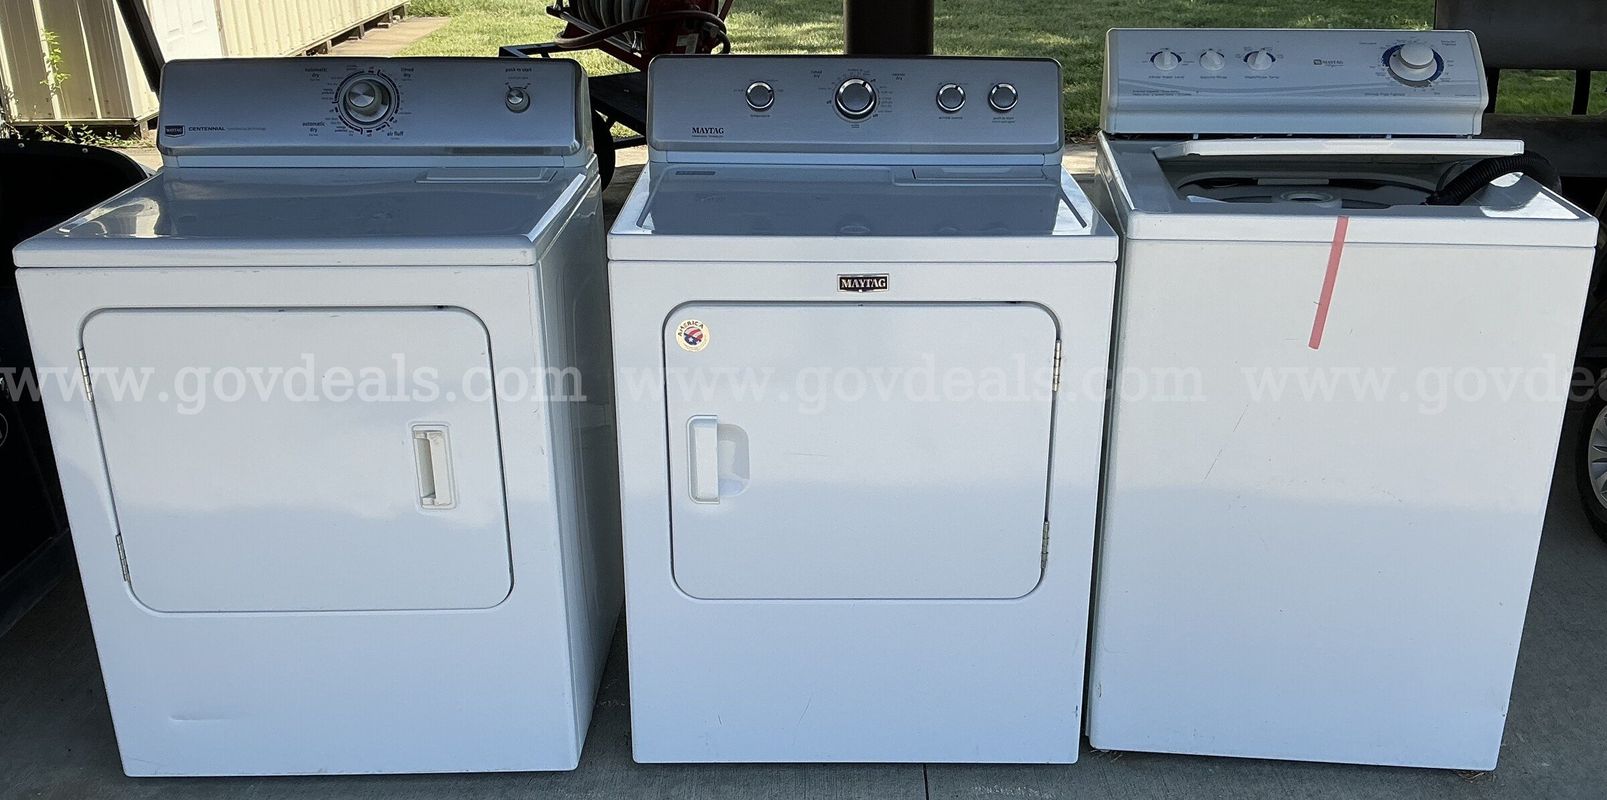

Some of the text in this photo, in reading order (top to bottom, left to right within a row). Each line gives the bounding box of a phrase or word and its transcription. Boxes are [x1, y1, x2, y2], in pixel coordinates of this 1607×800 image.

[691, 127, 724, 135] MAYTAG
[841, 278, 887, 289] MAYTAG
[677, 320, 704, 337] AMERICA
